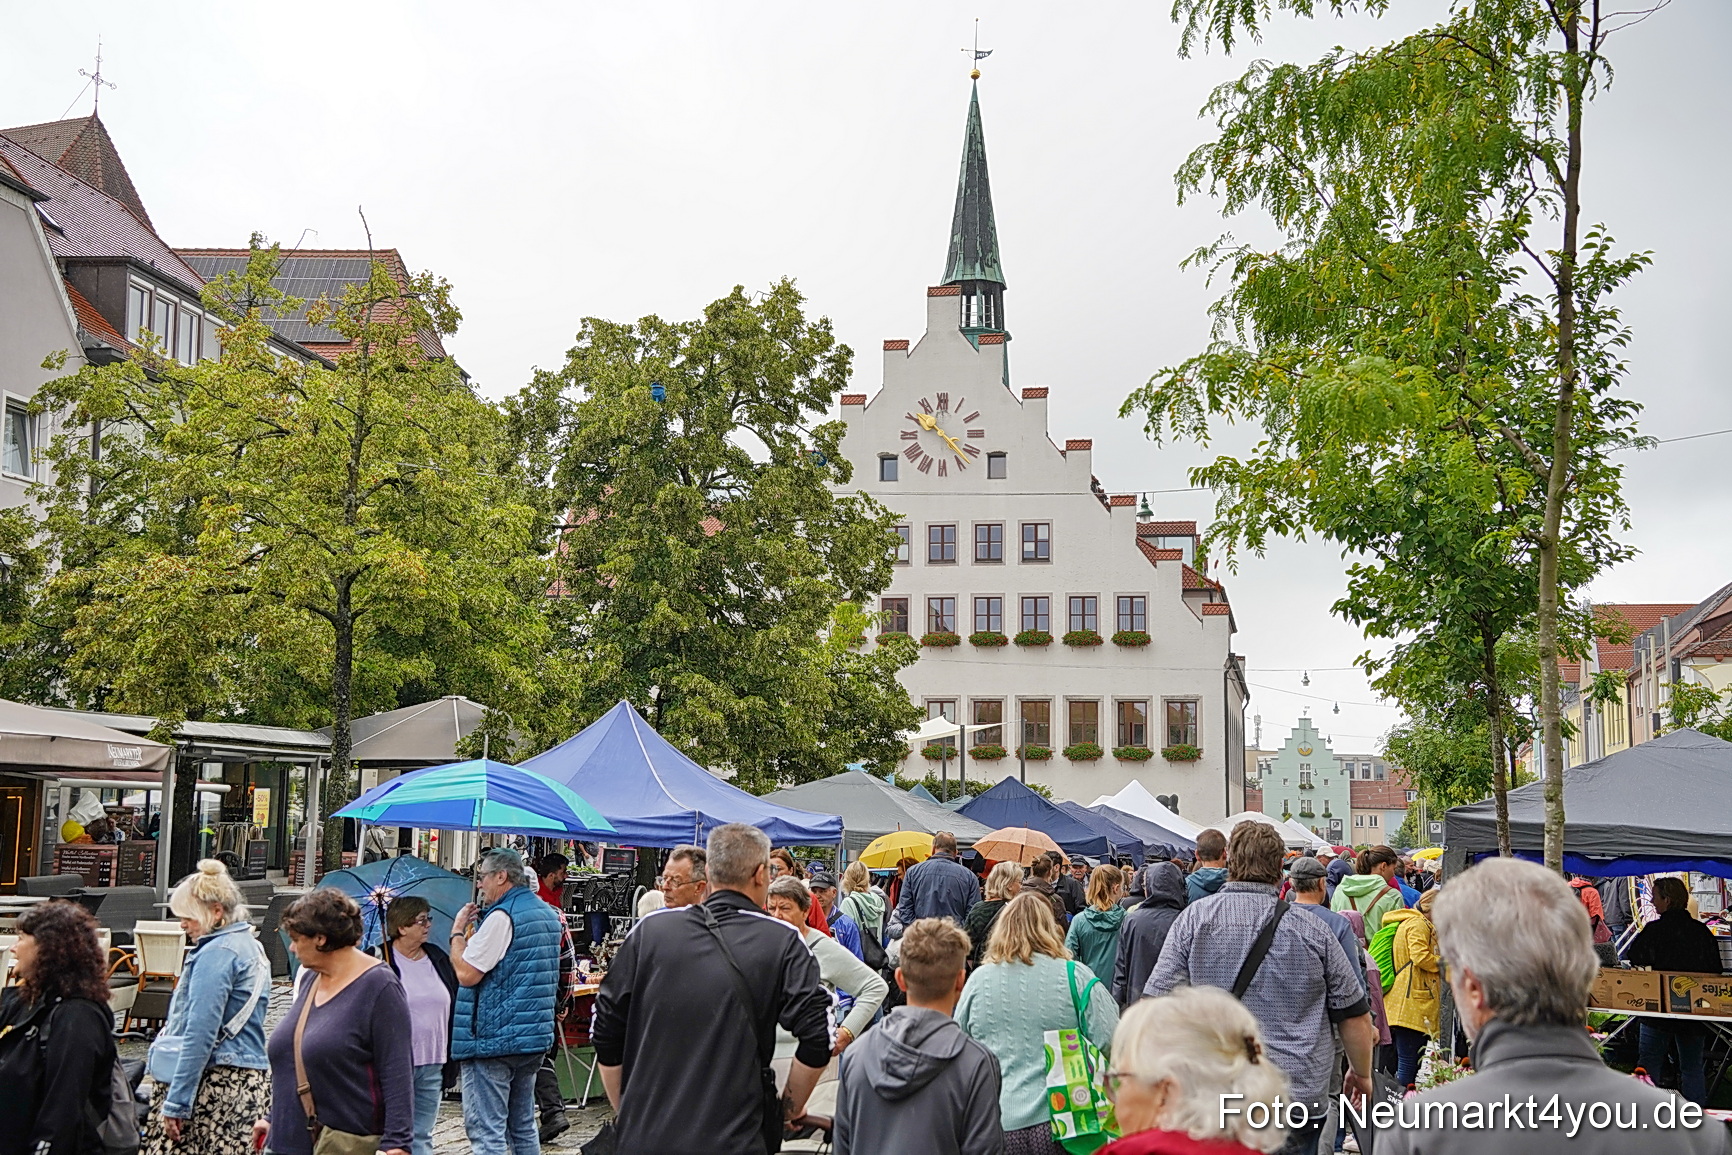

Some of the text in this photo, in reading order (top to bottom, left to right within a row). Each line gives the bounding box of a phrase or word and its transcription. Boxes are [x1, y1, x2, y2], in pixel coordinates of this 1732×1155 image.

[918, 397, 934, 415] XI
[936, 392, 949, 410] XII
[954, 397, 964, 413] I
[963, 411, 980, 423] II
[967, 429, 984, 438] III
